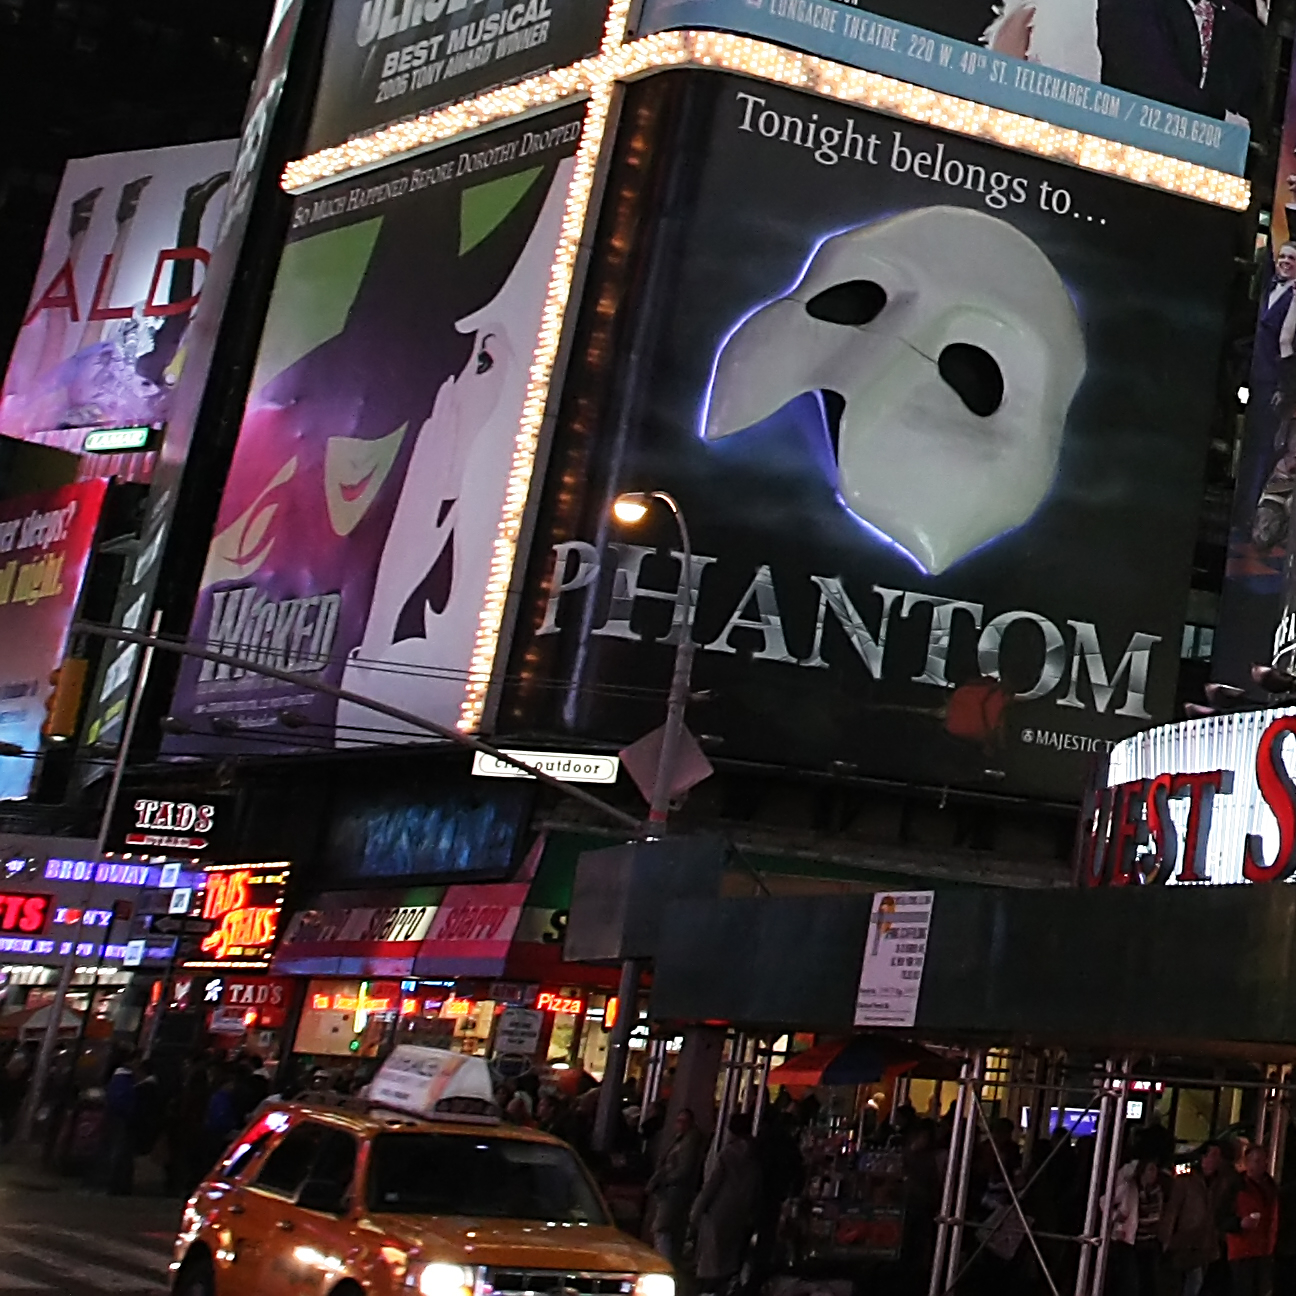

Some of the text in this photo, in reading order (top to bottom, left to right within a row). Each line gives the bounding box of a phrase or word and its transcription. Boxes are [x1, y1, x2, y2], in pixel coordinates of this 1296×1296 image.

[382, 34, 444, 79] BEST
[1015, 64, 1121, 119] TELECHARGE.COM
[737, 92, 879, 167] Tonight
[890, 131, 1029, 210] belongs
[534, 540, 1162, 721] PHANTOM
[1036, 729, 1102, 753] MAJESTIC
[133, 799, 216, 833] TADS
[536, 992, 583, 1014] Pizza
